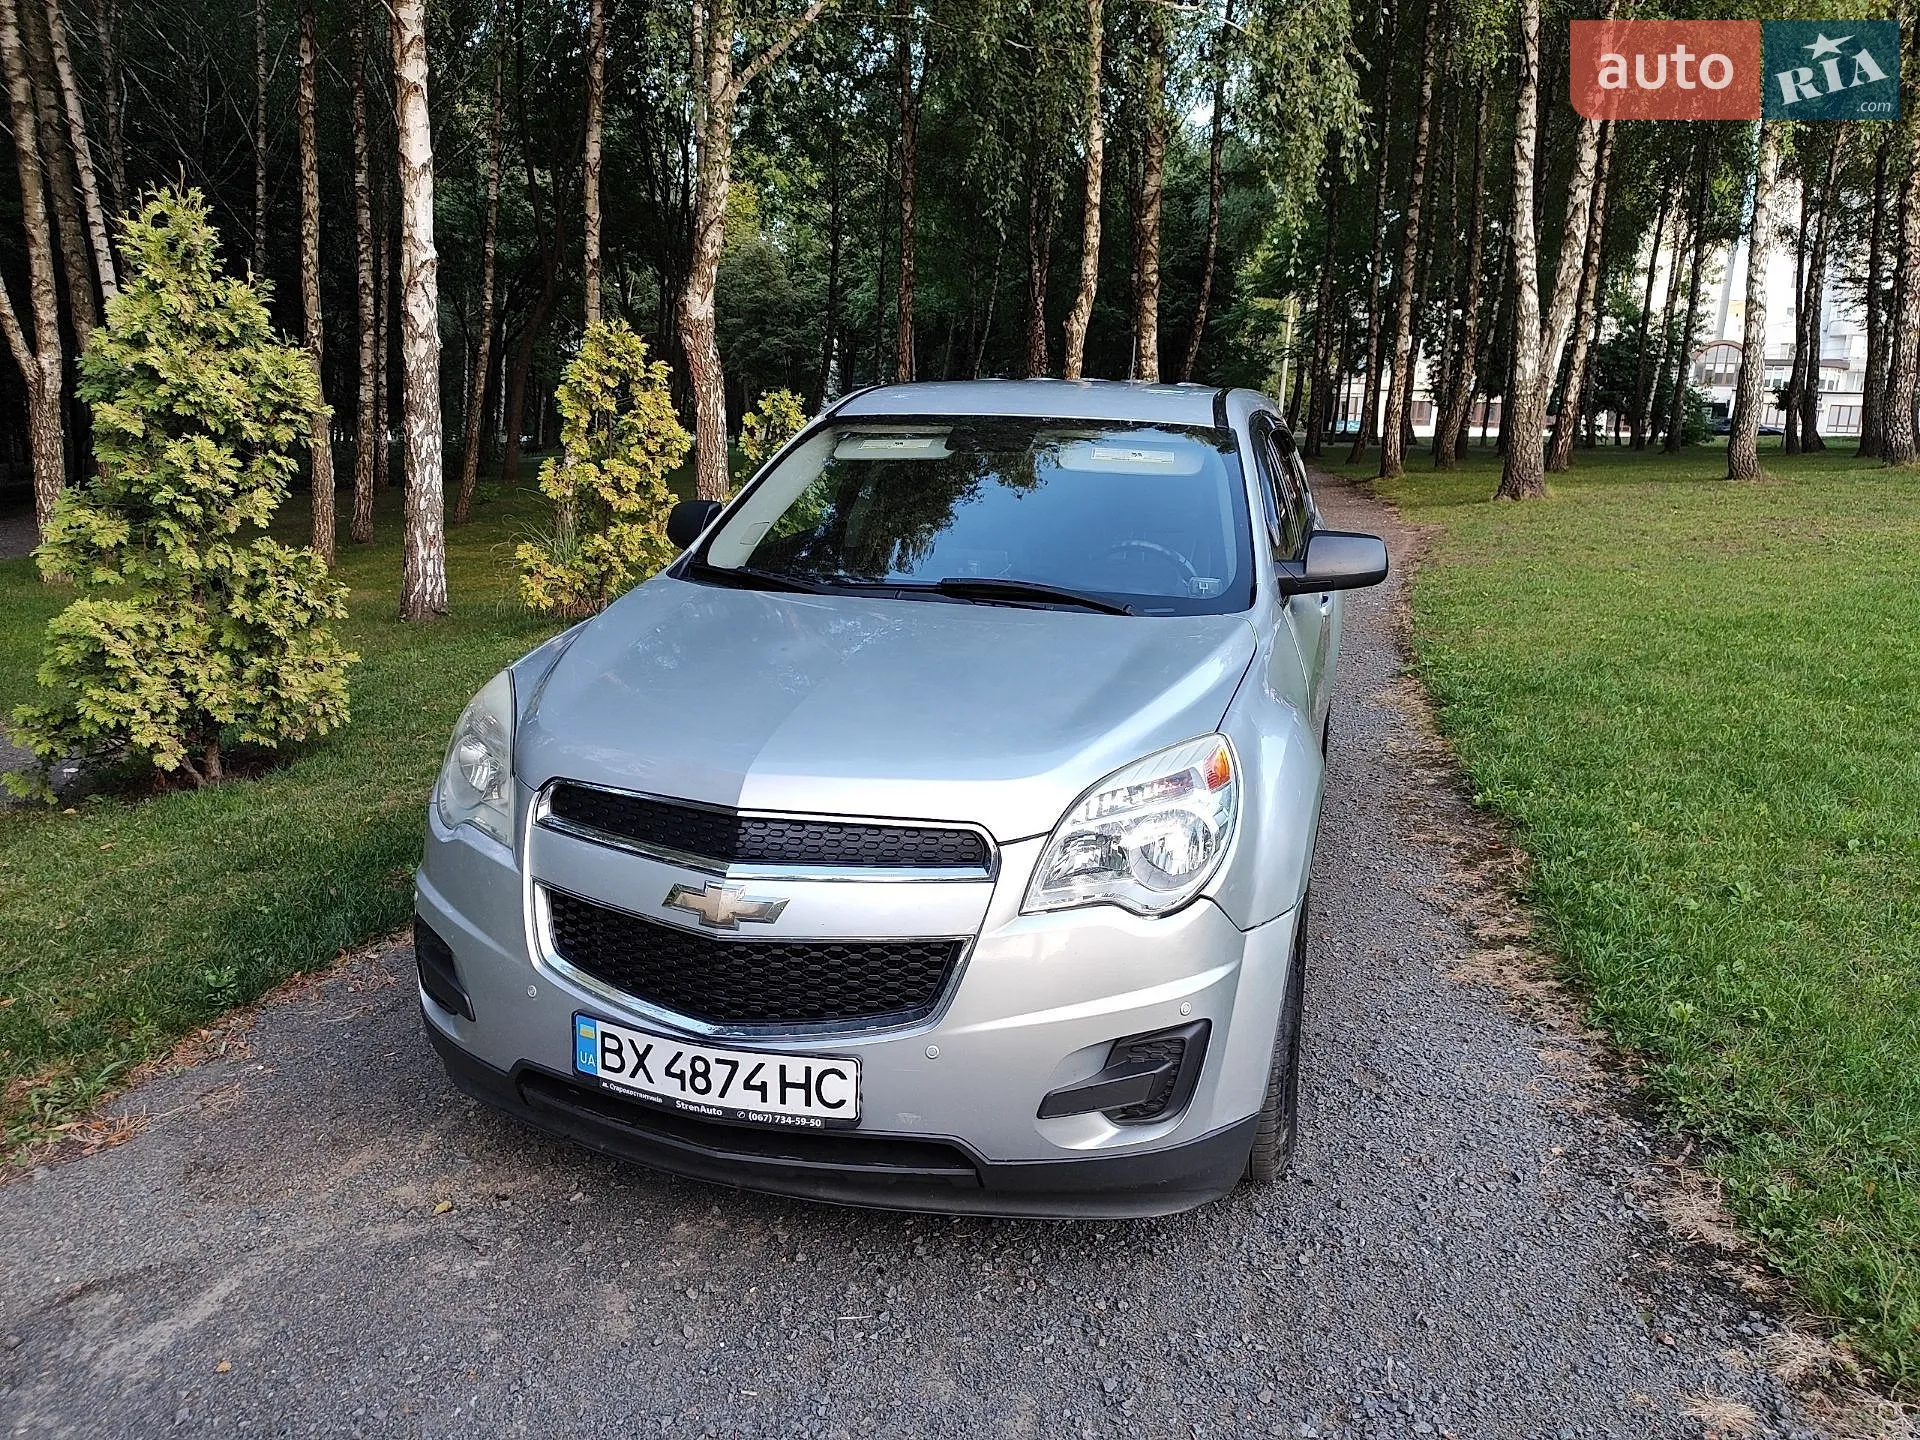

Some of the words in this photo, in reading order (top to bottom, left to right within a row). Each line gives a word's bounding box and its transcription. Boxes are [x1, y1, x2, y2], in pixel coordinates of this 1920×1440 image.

[579, 1051, 596, 1067] UA
[599, 1031, 655, 1084] BX
[664, 1051, 768, 1103] 4874
[779, 1065, 848, 1109] HC
[675, 1100, 723, 1116] StrenAuto
[748, 1112, 772, 1124] (067)
[774, 1115, 822, 1128] 734-59-50
